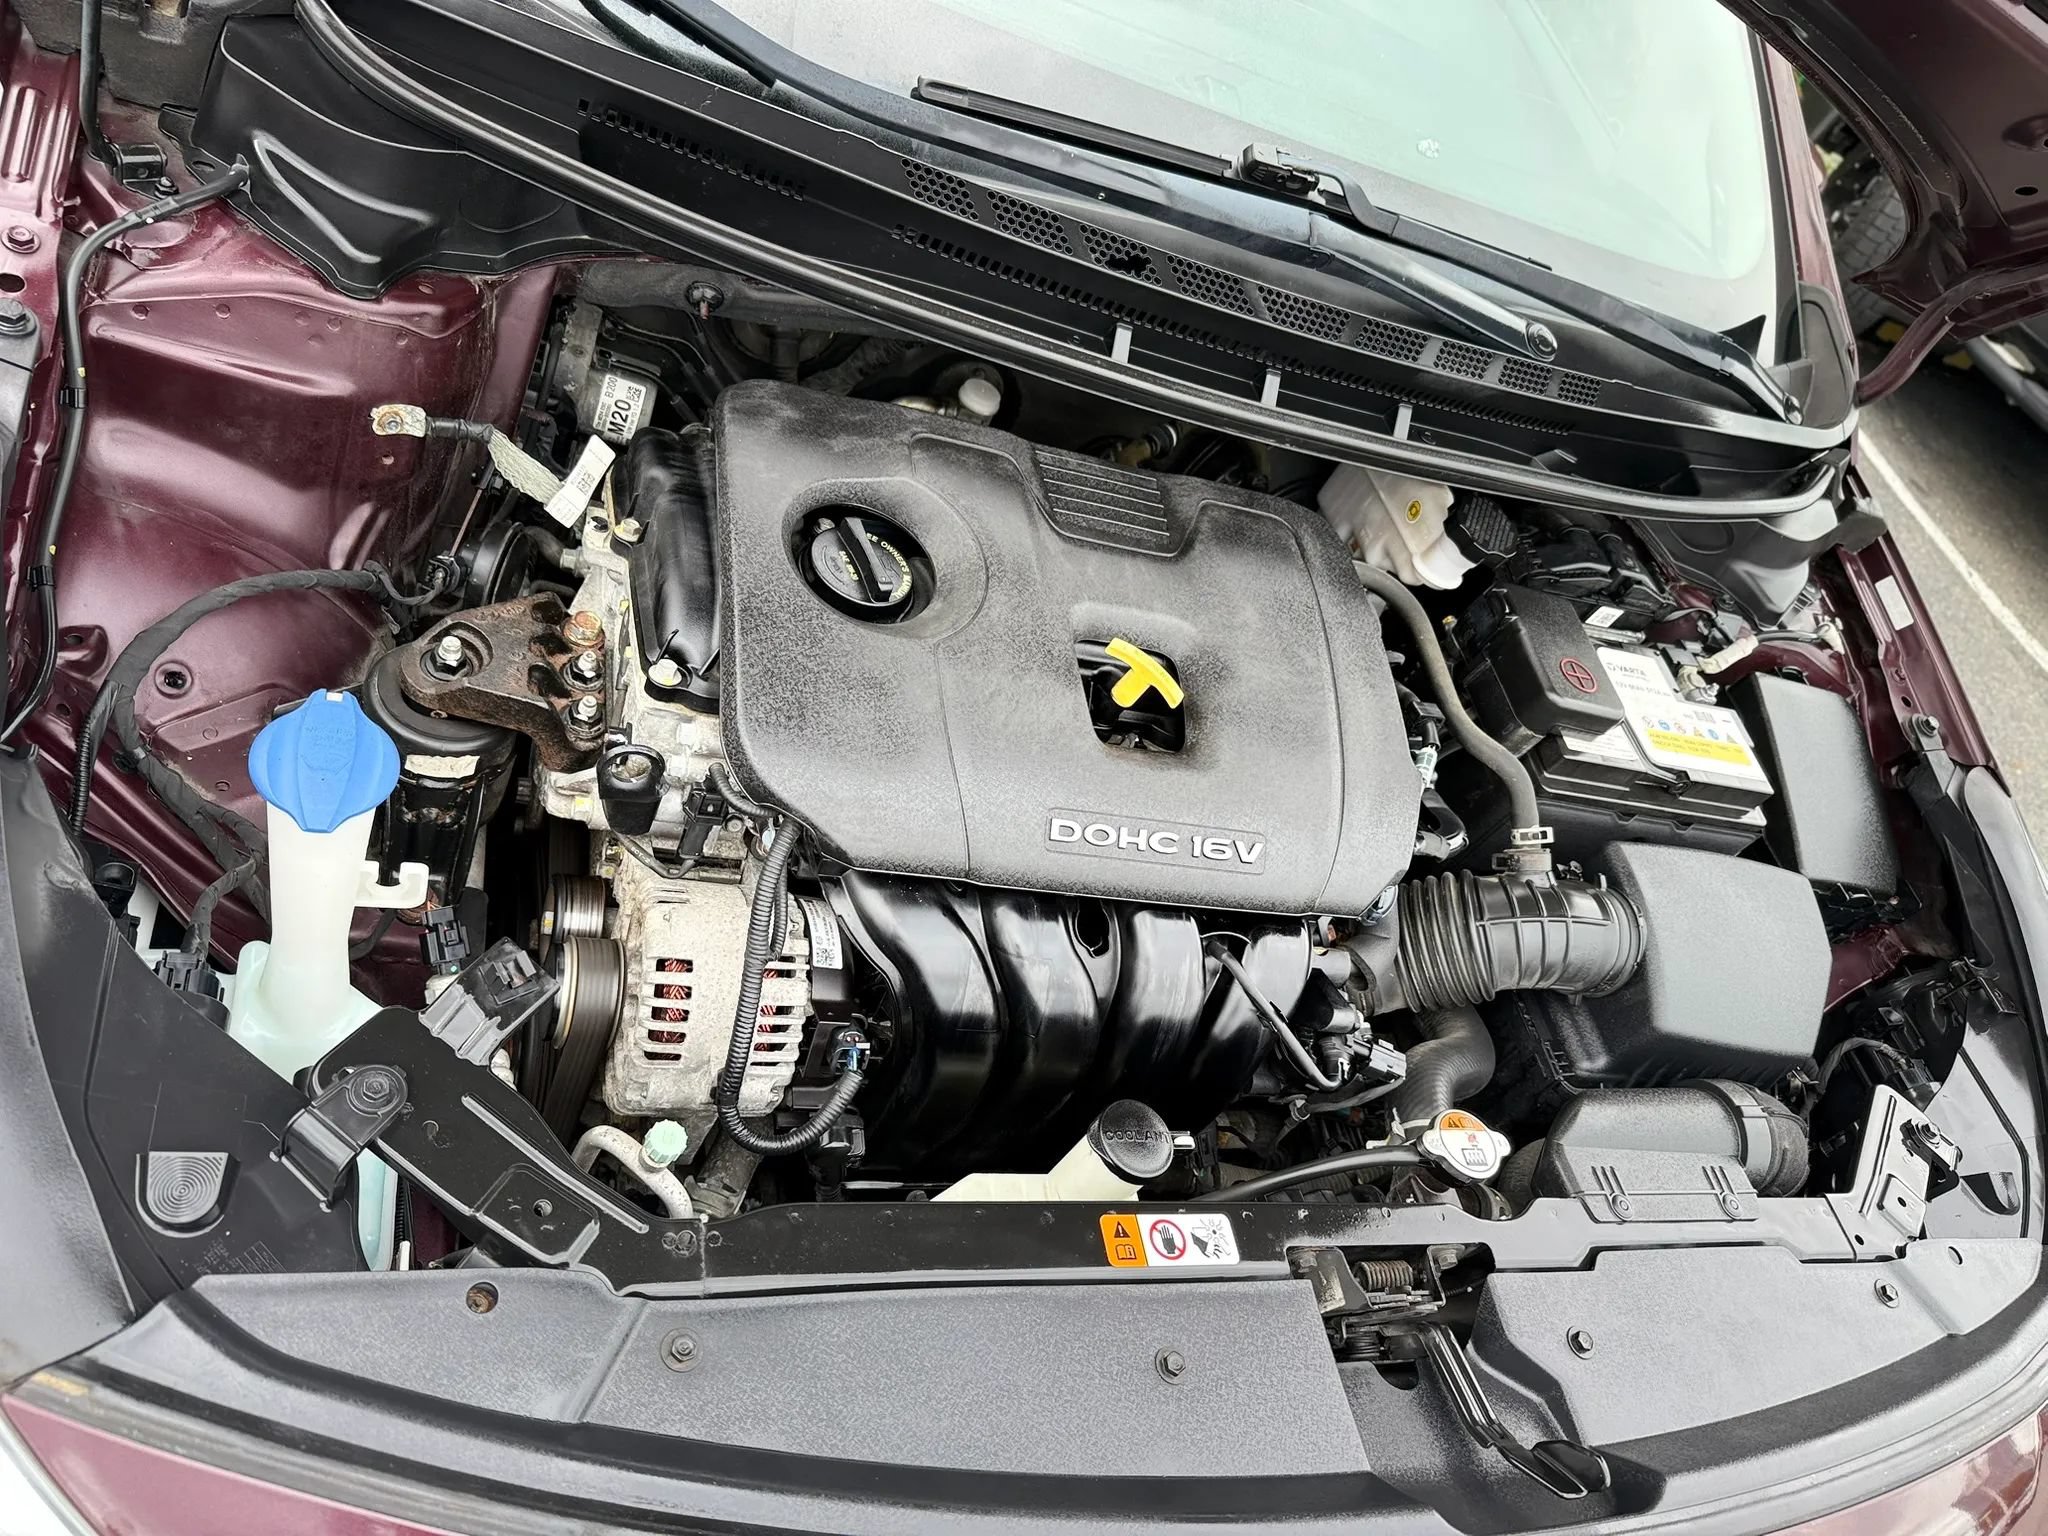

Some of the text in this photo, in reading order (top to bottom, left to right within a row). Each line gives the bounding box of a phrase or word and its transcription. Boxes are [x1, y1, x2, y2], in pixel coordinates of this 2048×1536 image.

[607, 398, 632, 437] M20
[1049, 817, 1265, 864] DOHC 16V
[1104, 1128, 1170, 1144] COOLANT
